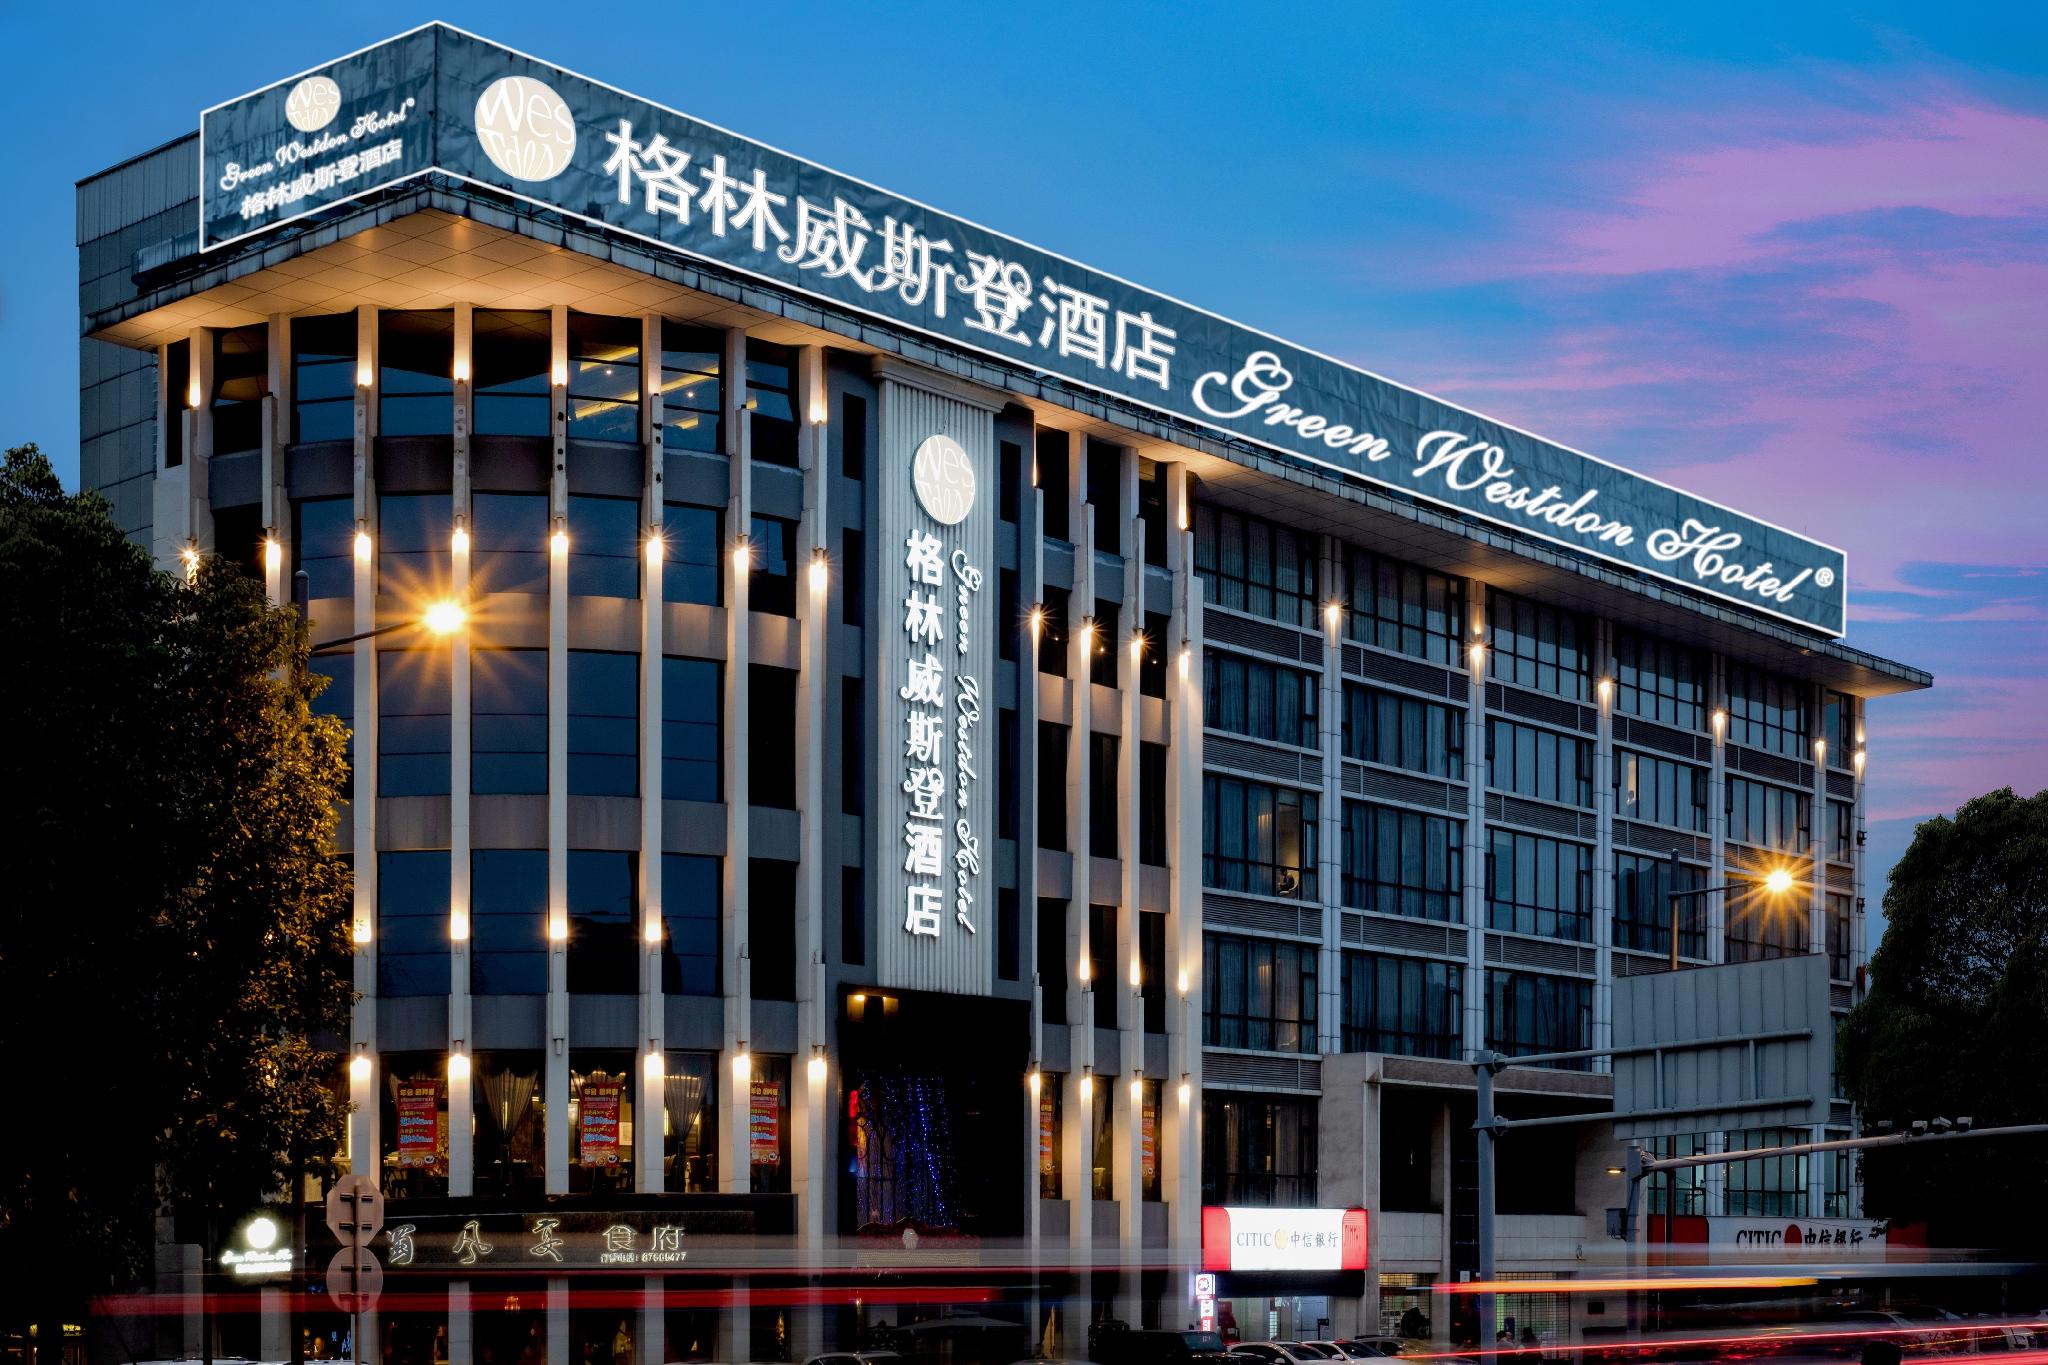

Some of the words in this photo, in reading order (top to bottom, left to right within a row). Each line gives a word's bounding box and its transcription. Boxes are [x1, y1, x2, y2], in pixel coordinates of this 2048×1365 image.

[220, 161, 274, 191] Green
[275, 132, 348, 168] Westdon
[239, 138, 403, 220] 格林威斯登酒店
[603, 118, 1178, 392] 格林威斯登酒店
[1192, 350, 1391, 463] Green
[1412, 430, 1635, 547] Westdon
[950, 549, 982, 654] Green
[900, 528, 945, 937] 格林威斯登酒店
[956, 675, 980, 809] Westdon
[955, 818, 980, 934] Hotel
[1236, 1232, 1272, 1247] CITIC
[1291, 1230, 1339, 1248] 中信银行
[1736, 1229, 1782, 1249] CITIC
[1804, 1227, 1864, 1250] 中信银行
